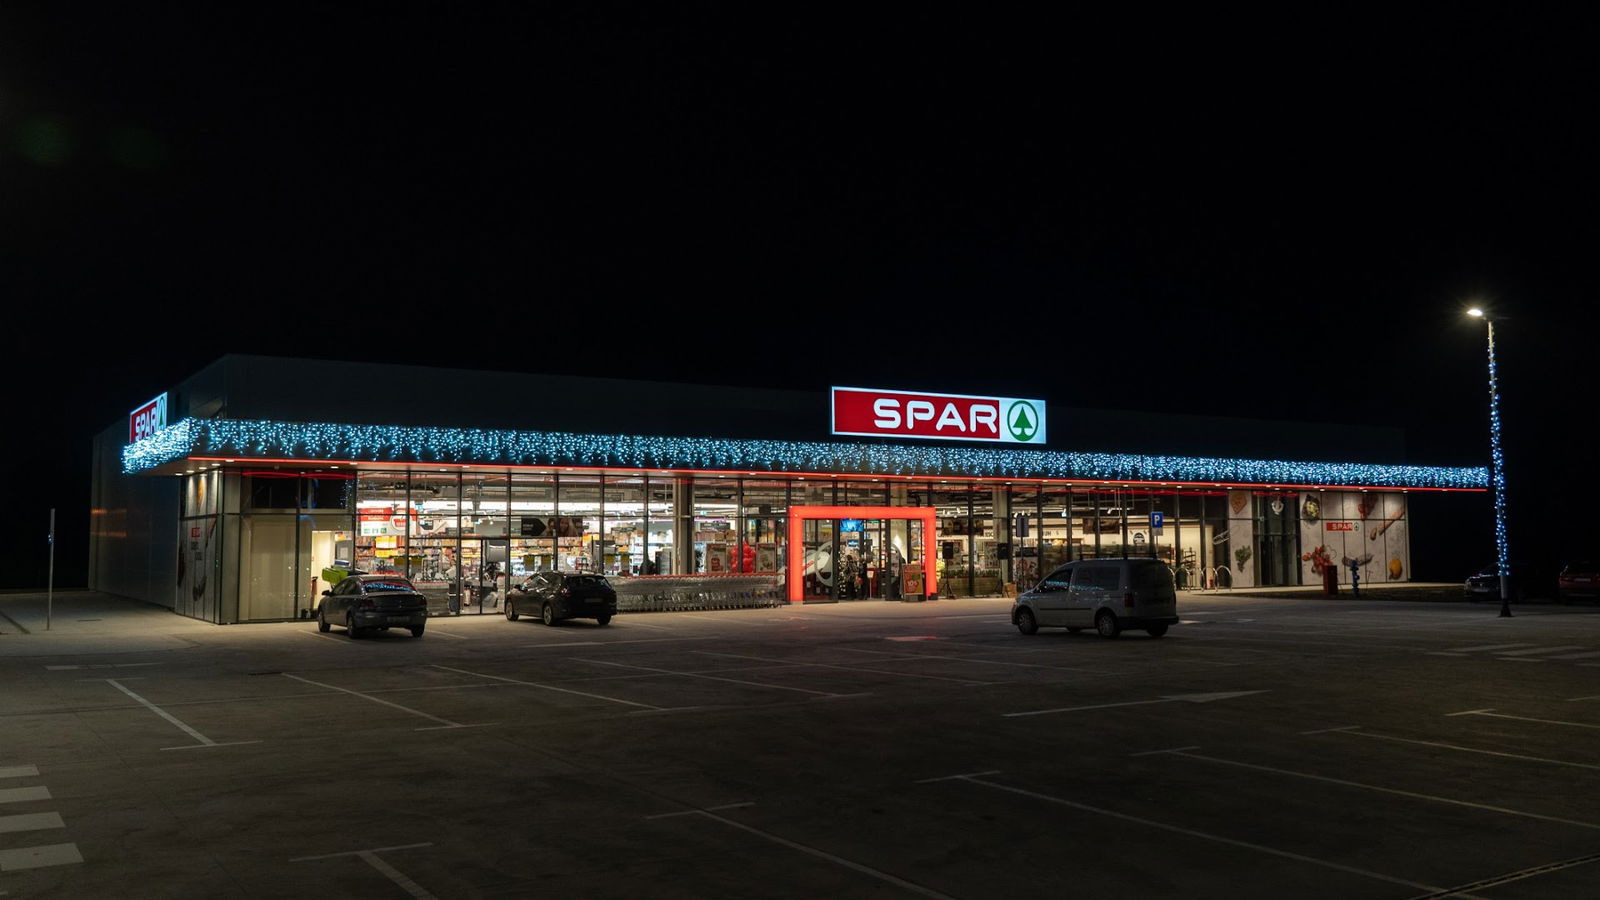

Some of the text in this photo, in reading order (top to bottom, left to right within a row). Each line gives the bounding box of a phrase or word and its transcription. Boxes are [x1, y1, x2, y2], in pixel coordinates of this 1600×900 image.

[135, 407, 157, 441] SPAR
[873, 398, 997, 433] SPAR
[1154, 514, 1161, 526] P
[1332, 523, 1353, 531] SPAR
